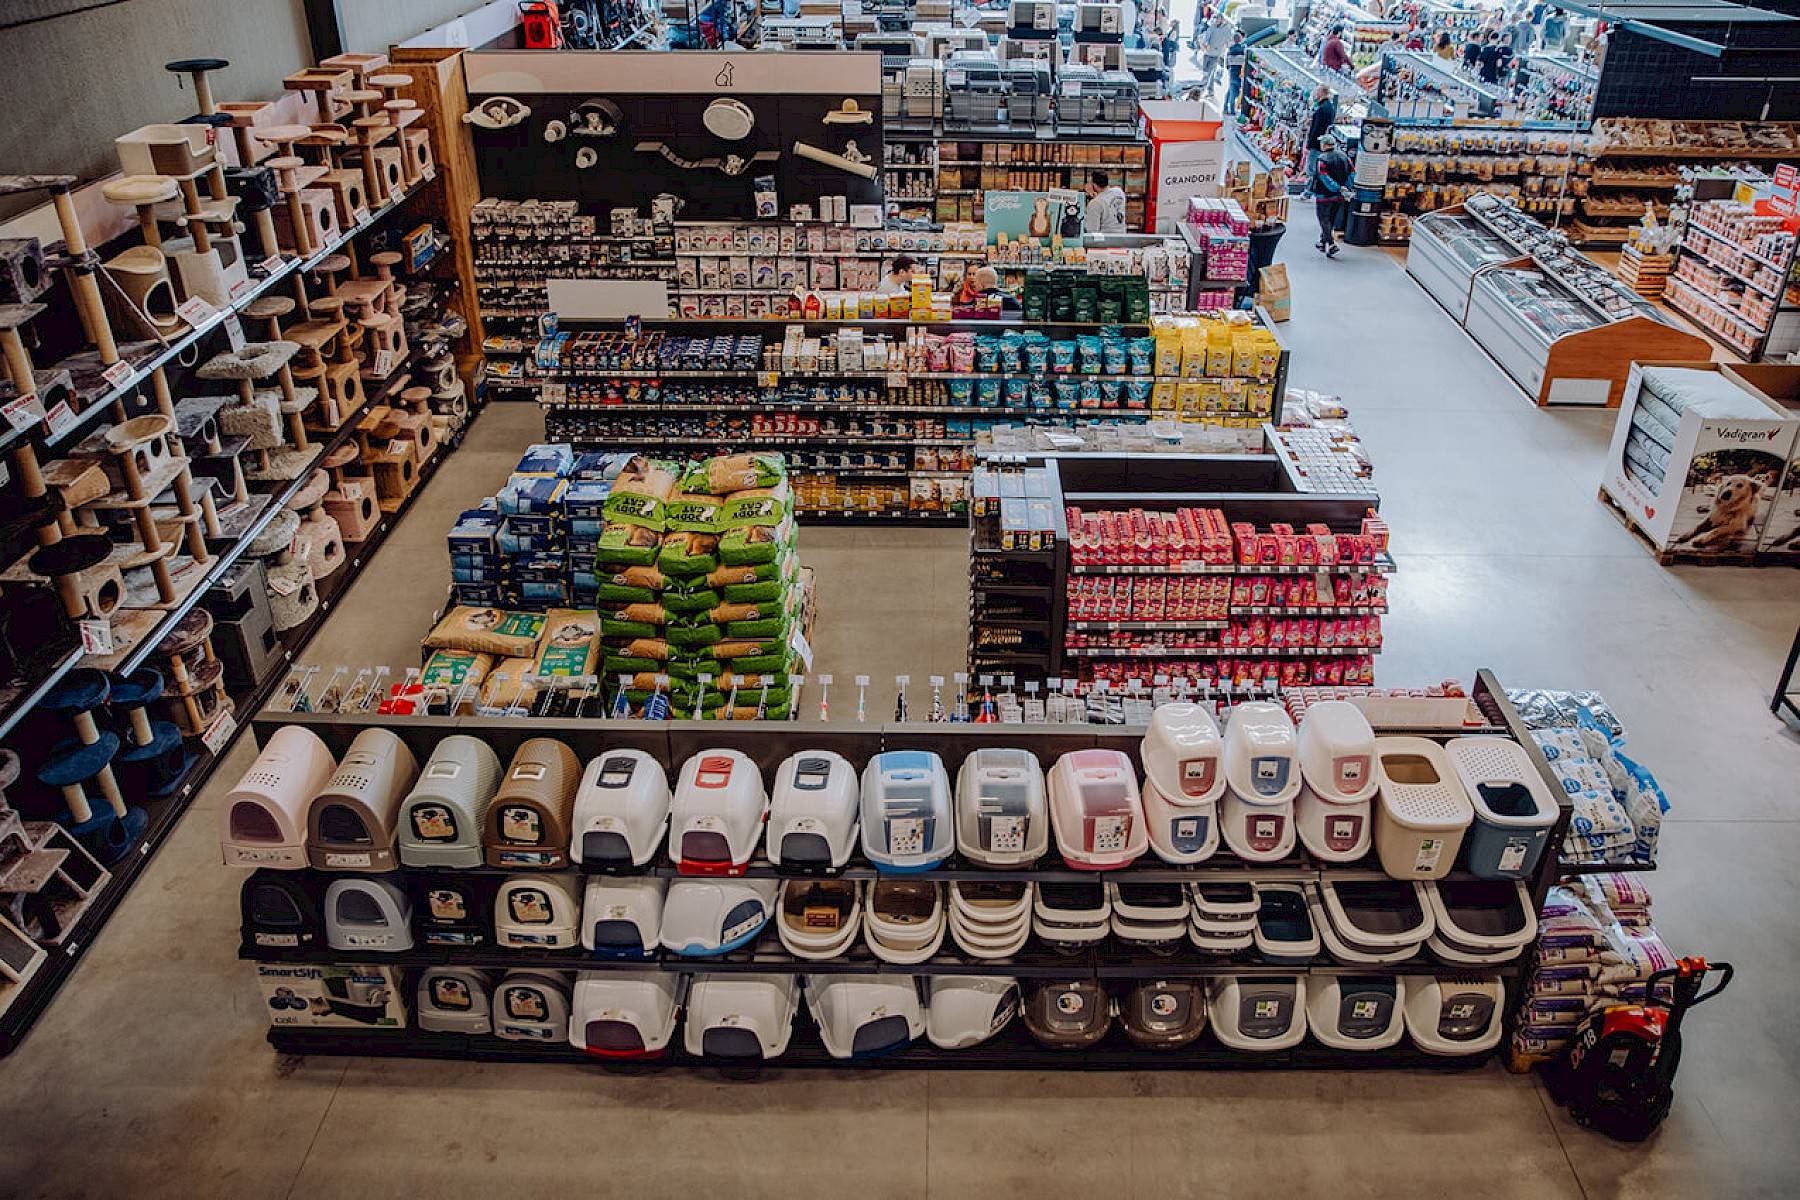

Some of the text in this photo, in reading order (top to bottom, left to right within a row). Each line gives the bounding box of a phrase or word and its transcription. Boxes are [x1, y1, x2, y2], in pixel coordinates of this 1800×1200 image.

[1165, 174, 1216, 186] GRANDORF
[1717, 427, 1766, 442] Vadigran
[258, 966, 324, 979] SmartSift
